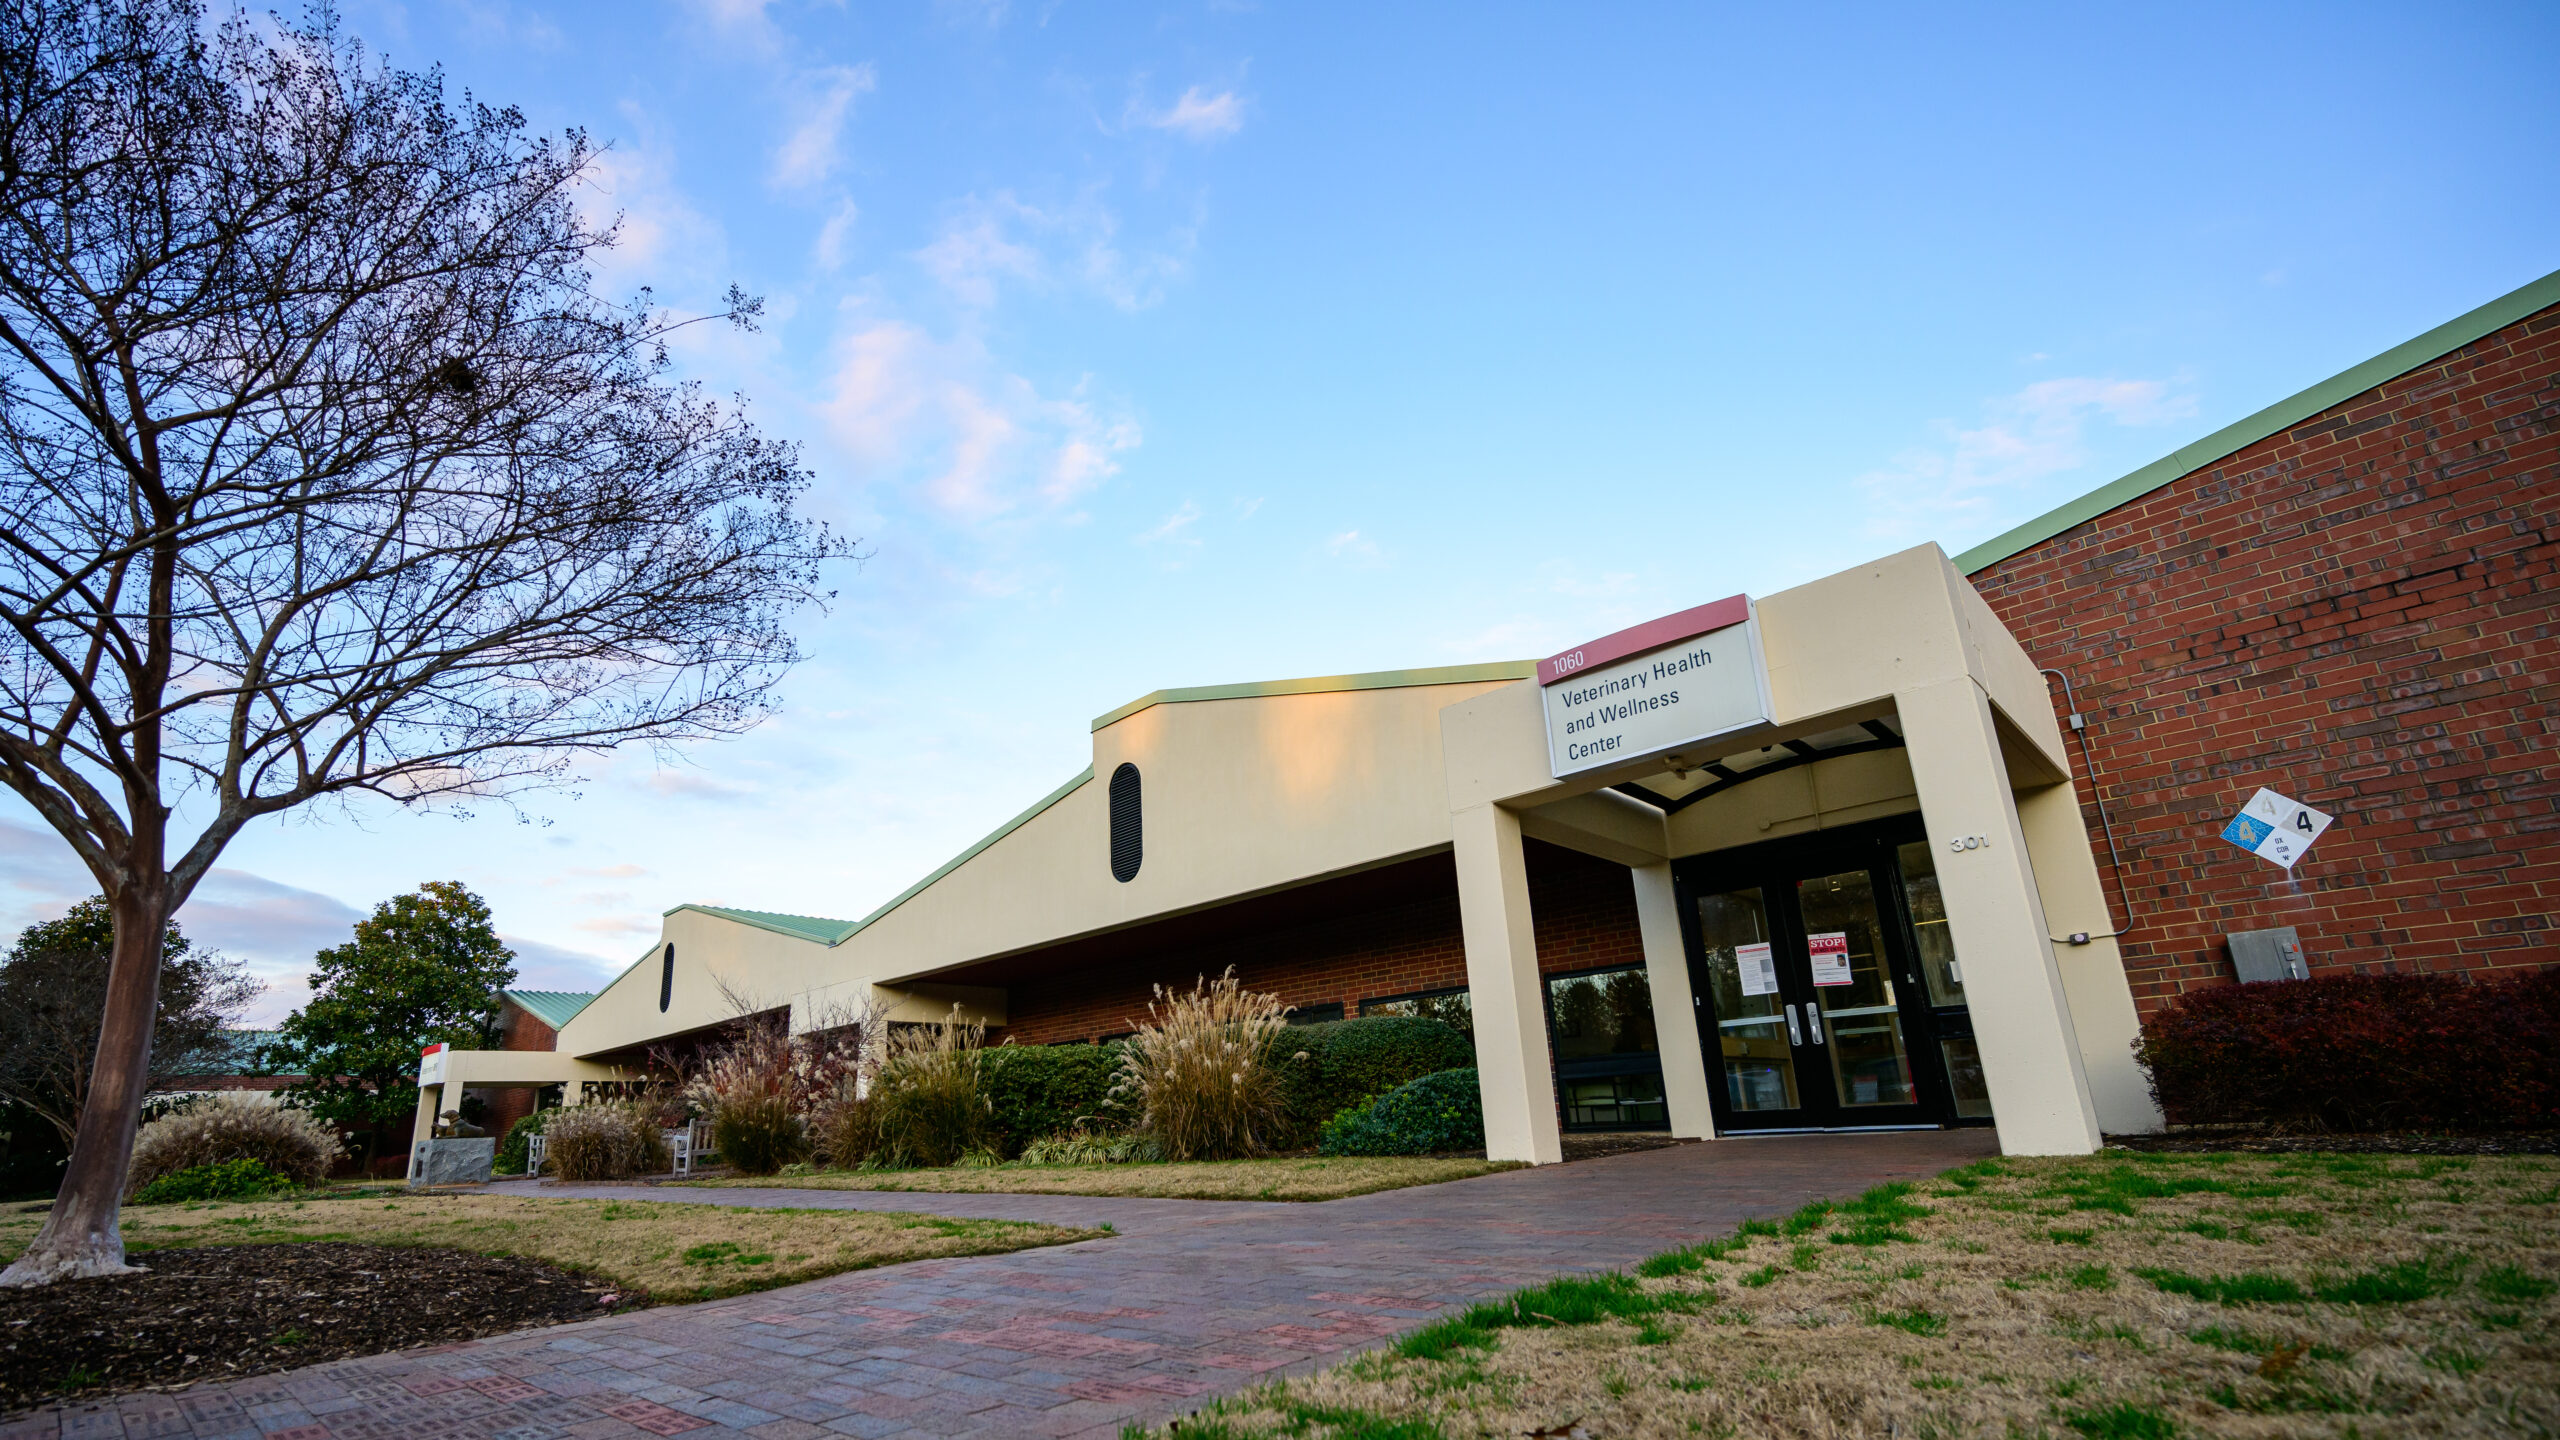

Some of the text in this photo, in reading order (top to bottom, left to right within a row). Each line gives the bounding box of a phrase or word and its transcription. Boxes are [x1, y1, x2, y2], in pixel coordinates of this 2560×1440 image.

[1552, 650, 1584, 675] 1060
[1562, 649, 1712, 708] Veterinary Health
[1566, 690, 1680, 734] and Wellness
[1569, 734, 1623, 760] Center
[2240, 821, 2256, 842] 4
[2297, 811, 2312, 832] 4
[1950, 832, 1989, 852] 301
[1811, 938, 1845, 948] STOP!
